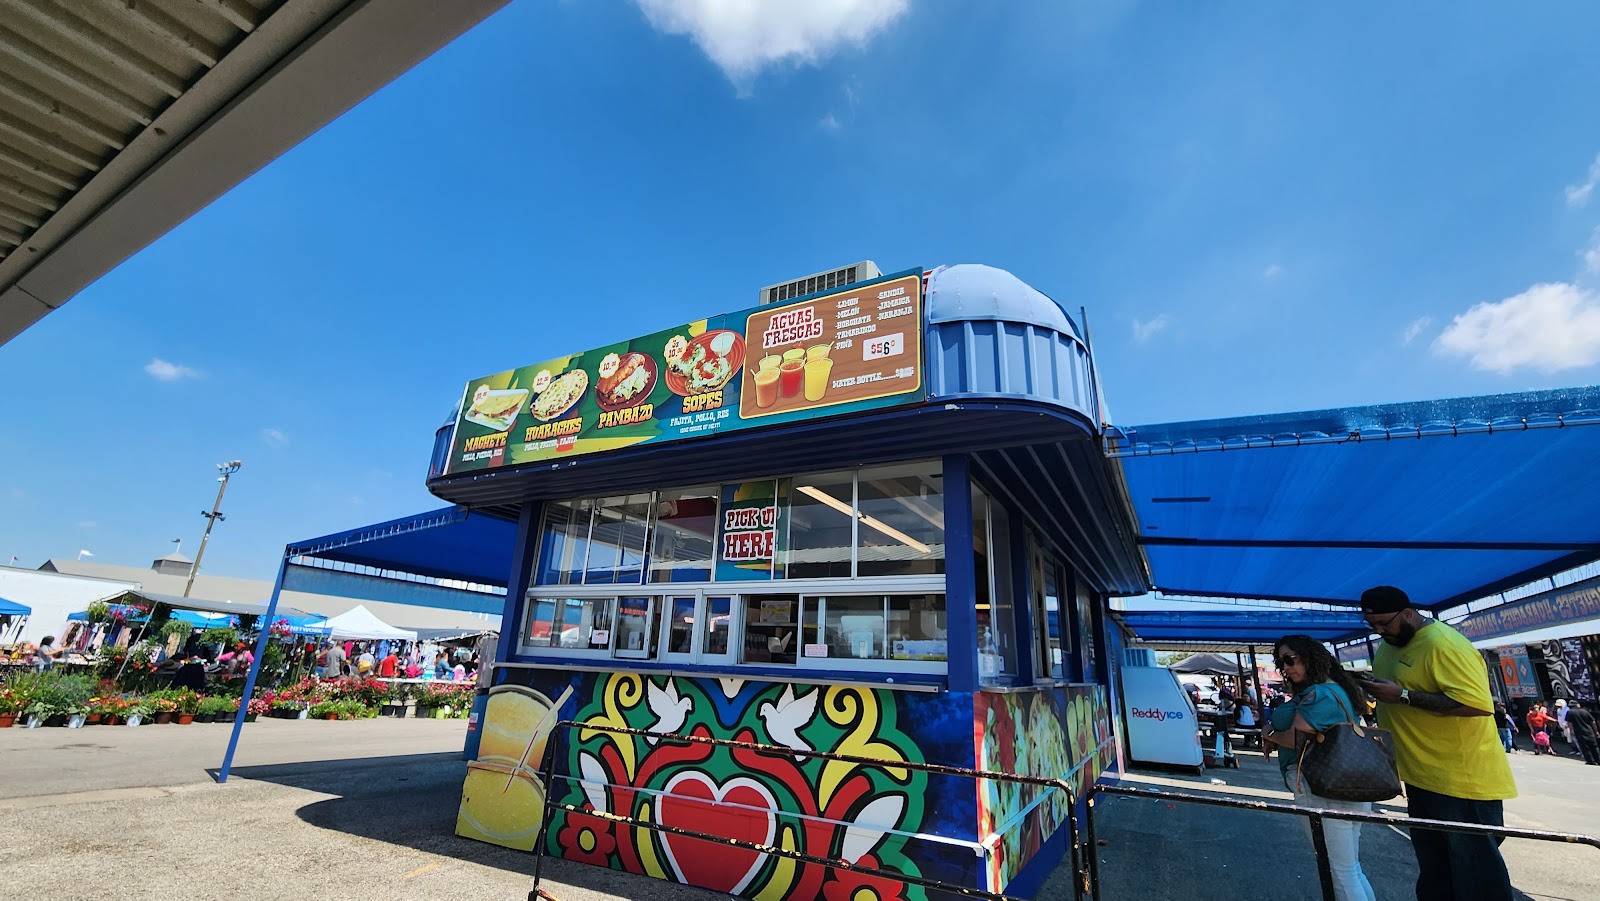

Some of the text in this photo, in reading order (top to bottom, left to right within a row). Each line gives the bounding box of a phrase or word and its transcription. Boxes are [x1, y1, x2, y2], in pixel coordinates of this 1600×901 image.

[770, 308, 813, 330] AGUAS
[765, 320, 822, 347] FRESCAS
[683, 391, 723, 414] SOPES
[597, 403, 654, 429] PAMBAZO
[695, 412, 716, 423] POLLO,
[717, 409, 729, 419] RES
[524, 417, 583, 442] HUARACHES
[463, 431, 509, 453] MACHETE
[726, 509, 758, 528] PICK
